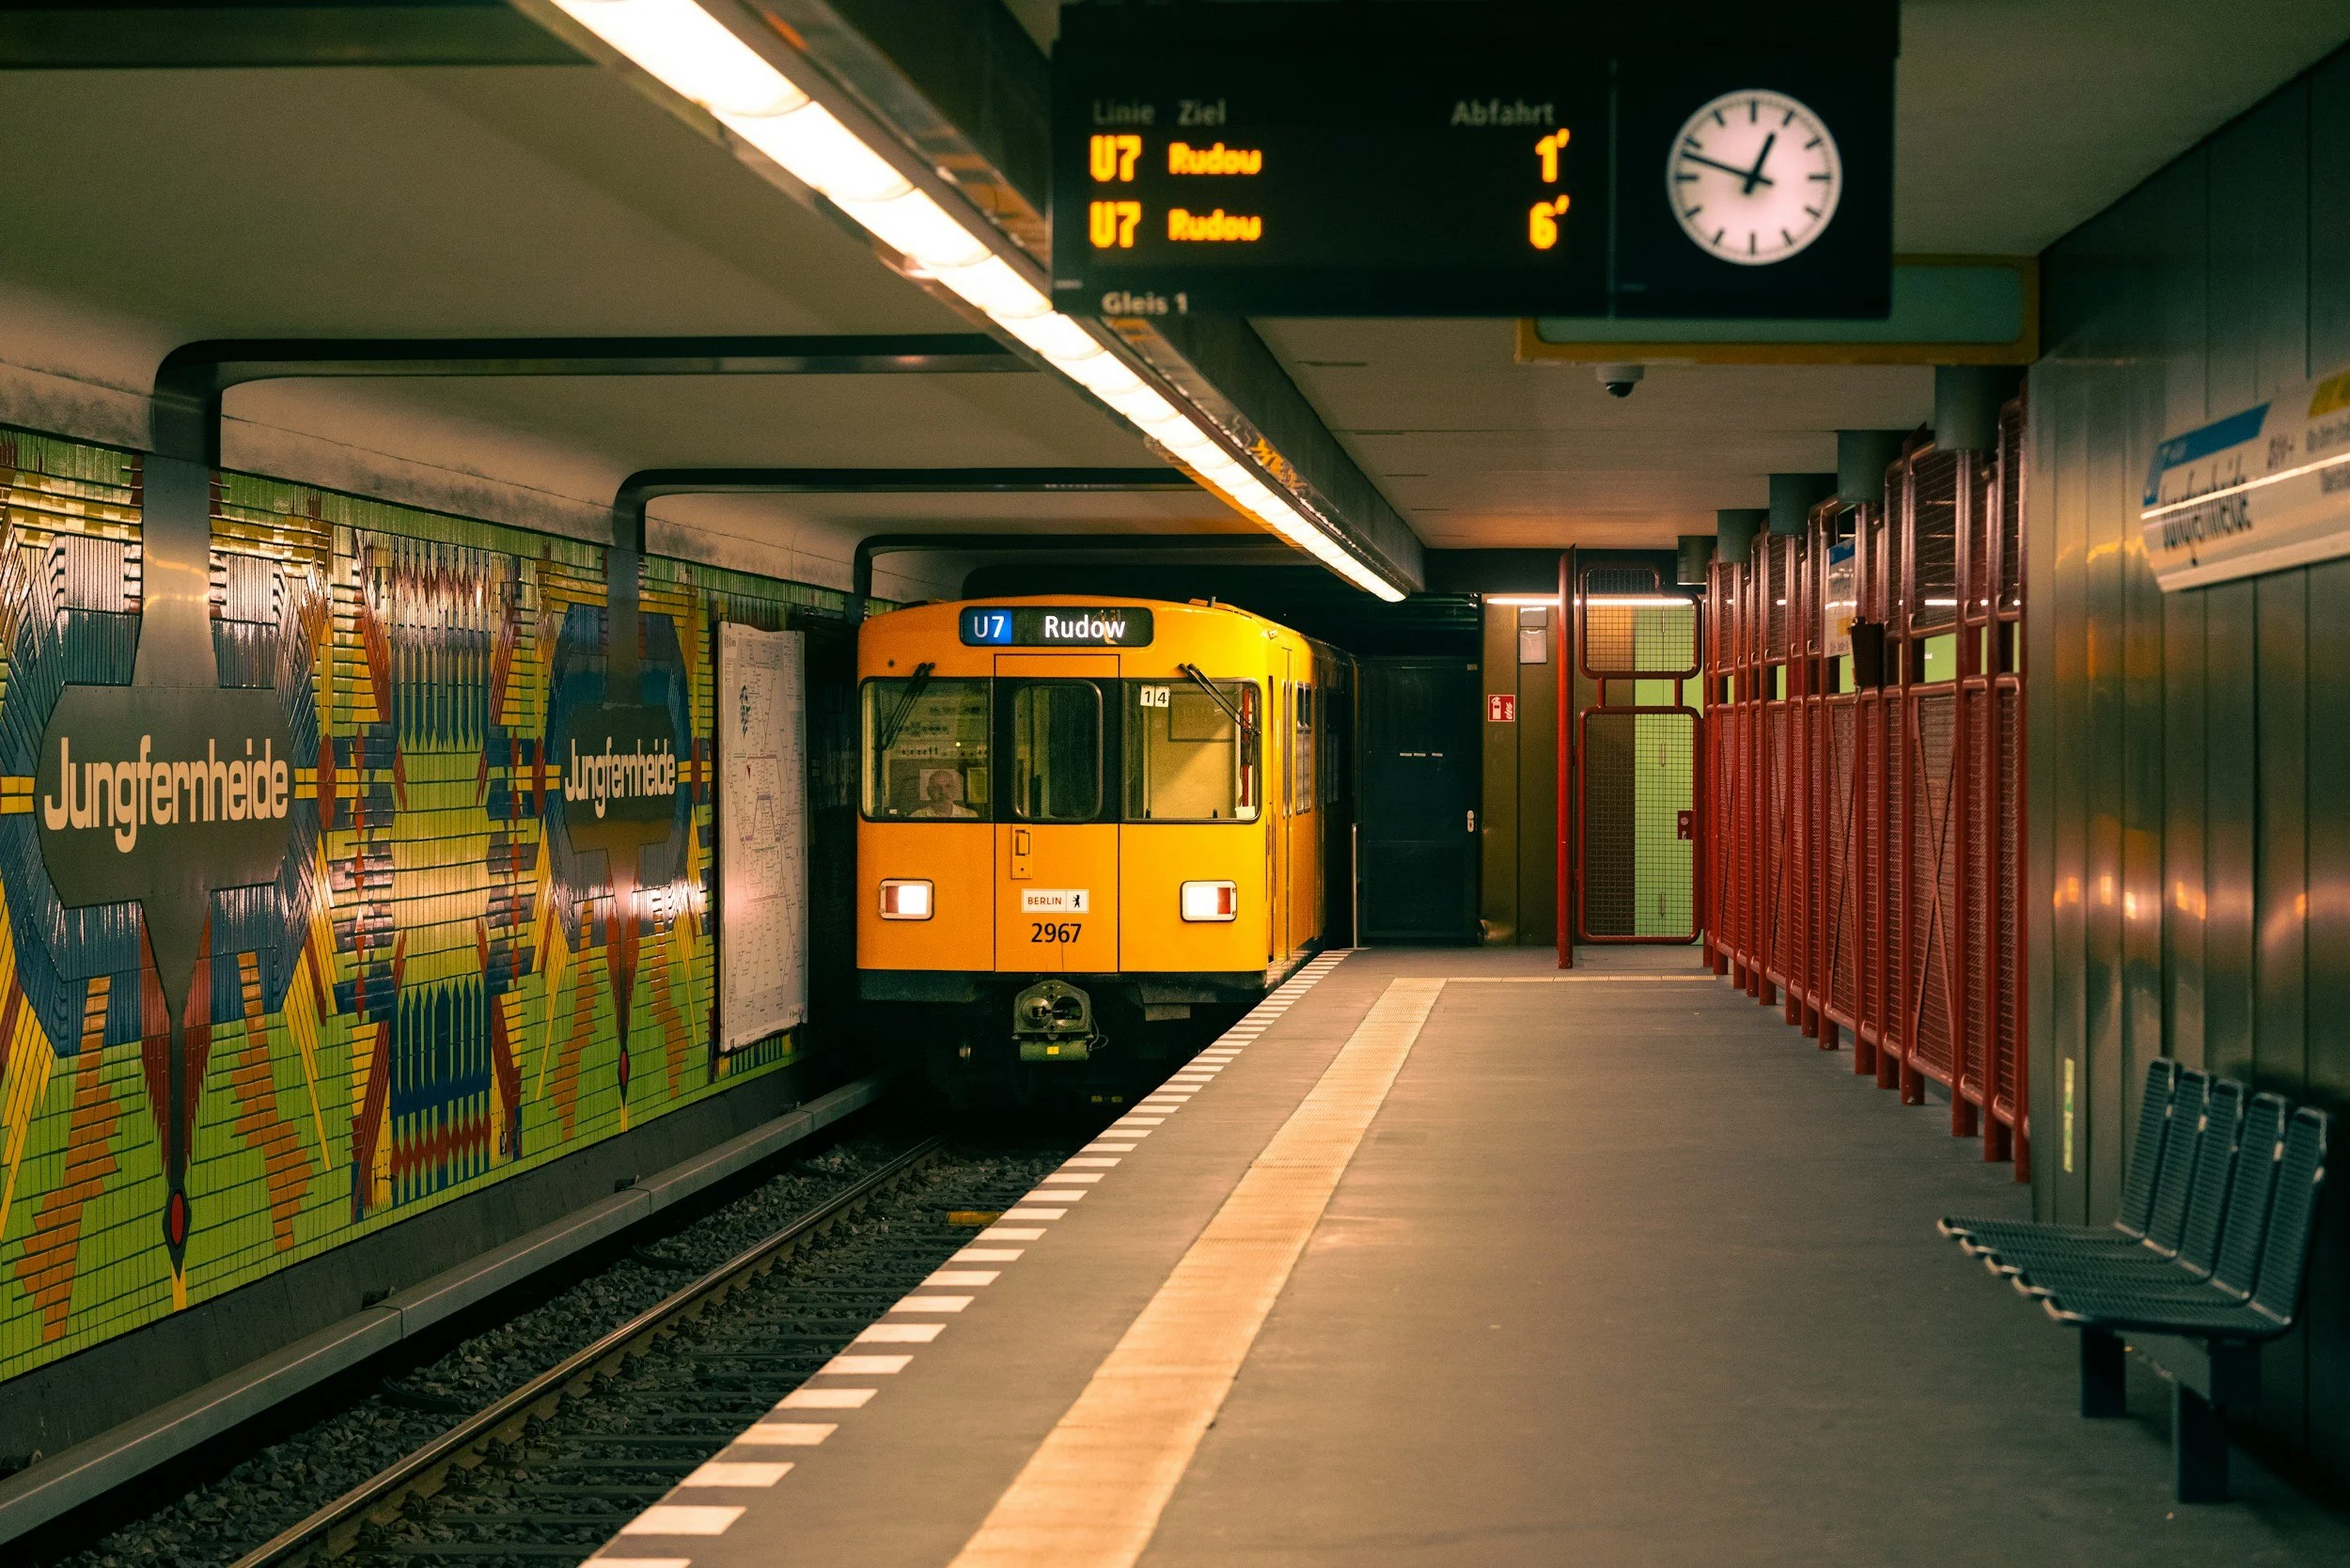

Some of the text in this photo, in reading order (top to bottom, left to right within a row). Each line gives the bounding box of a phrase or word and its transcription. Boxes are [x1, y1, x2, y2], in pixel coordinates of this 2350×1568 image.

[1093, 98, 1555, 127] Linie Ziel Abfahrt
[1089, 134, 1142, 181] U7
[1168, 142, 1262, 175] Rudow
[1089, 201, 1141, 248] U7
[1167, 209, 1261, 241] Rudow
[1101, 290, 1188, 316] Gleis 1
[974, 614, 1126, 638] U7 Rudow
[565, 736, 675, 819] Jungfernheide
[44, 734, 289, 854] Jungfernheide
[1027, 897, 1062, 905] BERLIN
[1031, 922, 1082, 943] 2967
